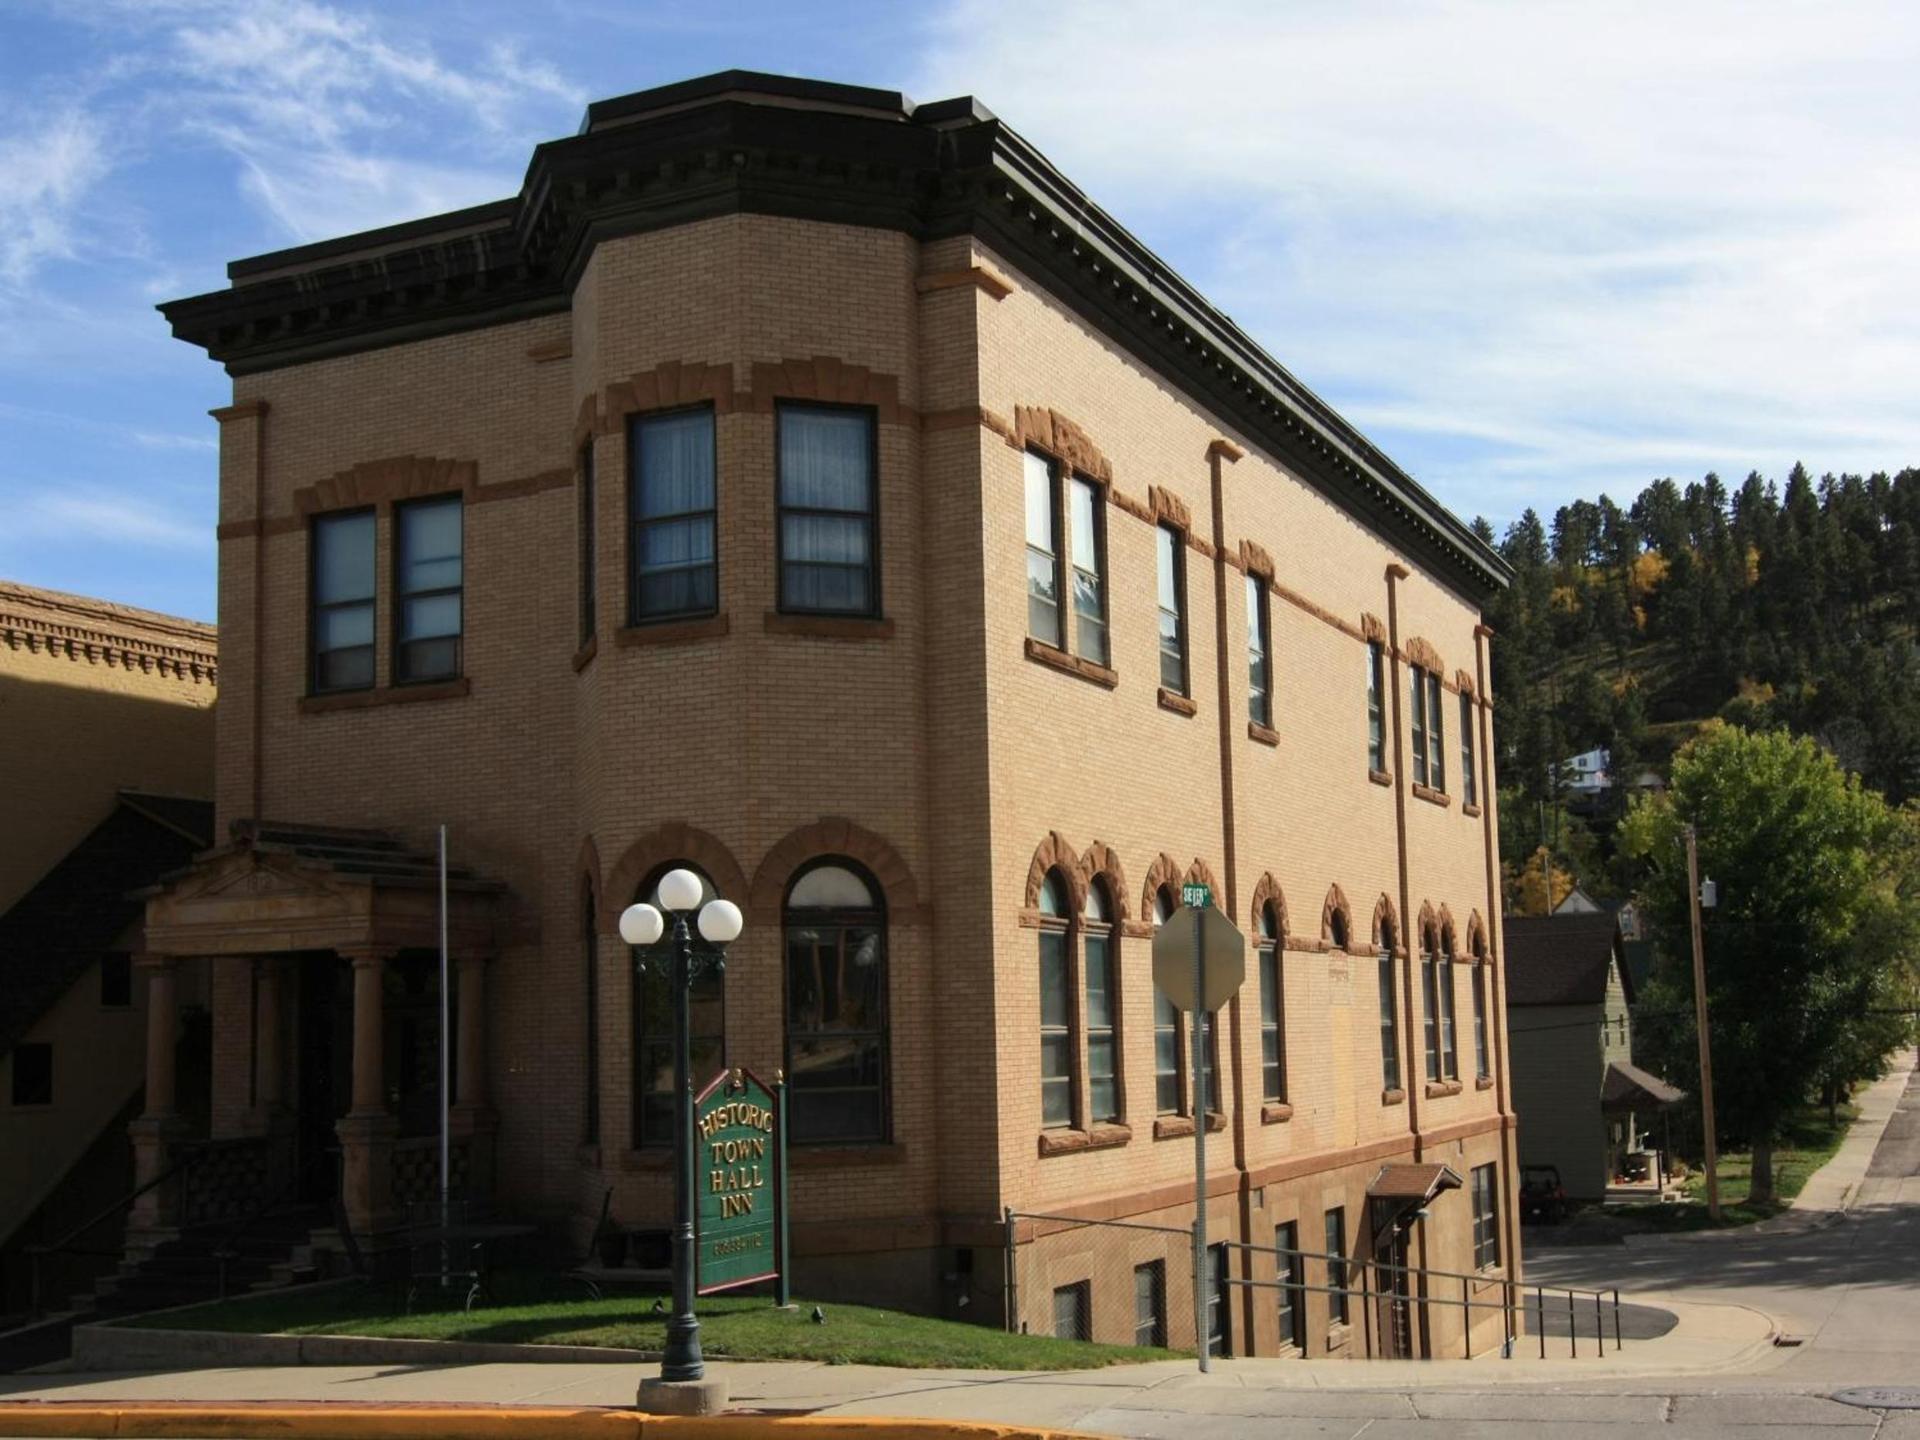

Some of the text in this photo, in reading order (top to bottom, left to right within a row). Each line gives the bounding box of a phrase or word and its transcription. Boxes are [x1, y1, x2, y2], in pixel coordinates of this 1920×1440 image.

[699, 1103, 773, 1140] HISTORIC
[711, 1138, 764, 1164] TOWN
[710, 1165, 763, 1193] HALL
[720, 1193, 753, 1219] INN
